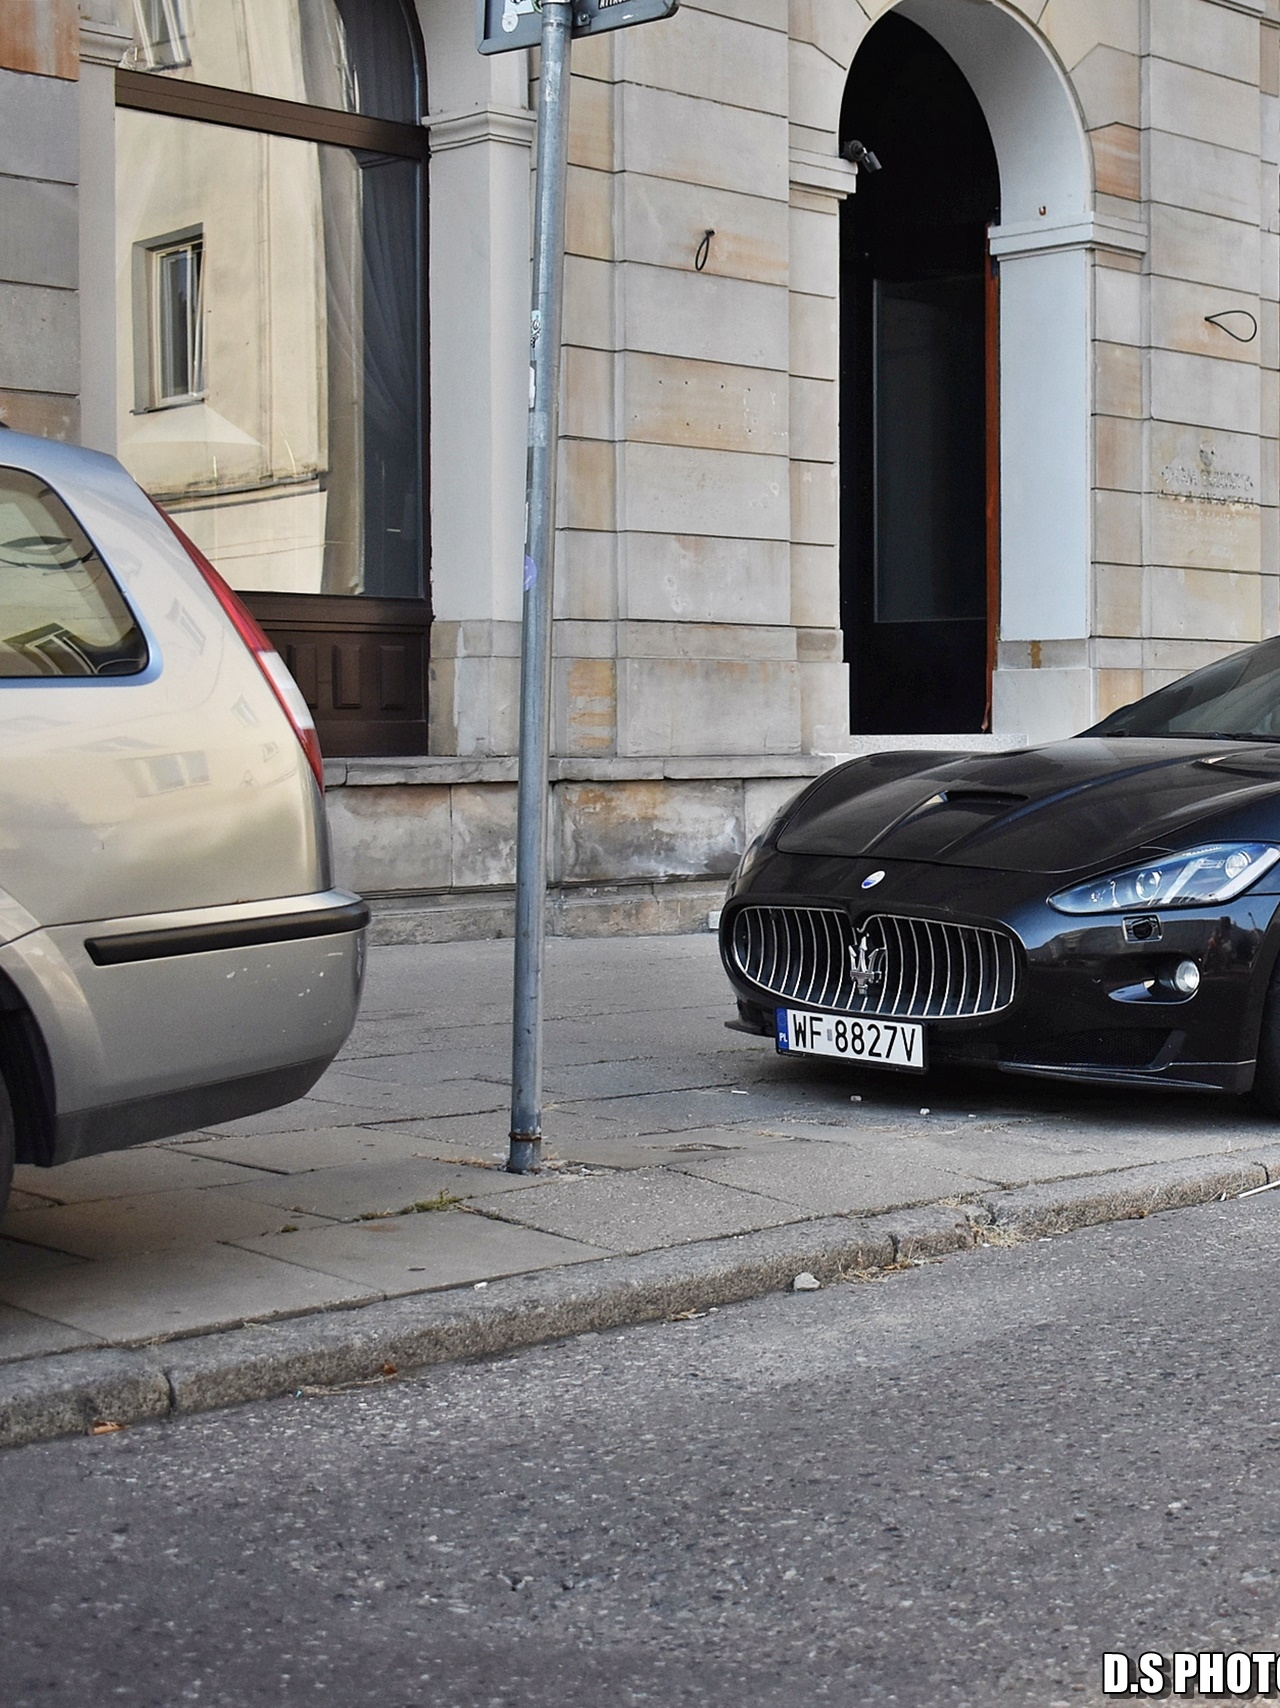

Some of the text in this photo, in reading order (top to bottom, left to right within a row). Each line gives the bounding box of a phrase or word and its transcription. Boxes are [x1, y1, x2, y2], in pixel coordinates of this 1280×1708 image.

[779, 1032, 788, 1042] PL
[793, 1014, 916, 1062] WF 8827V
